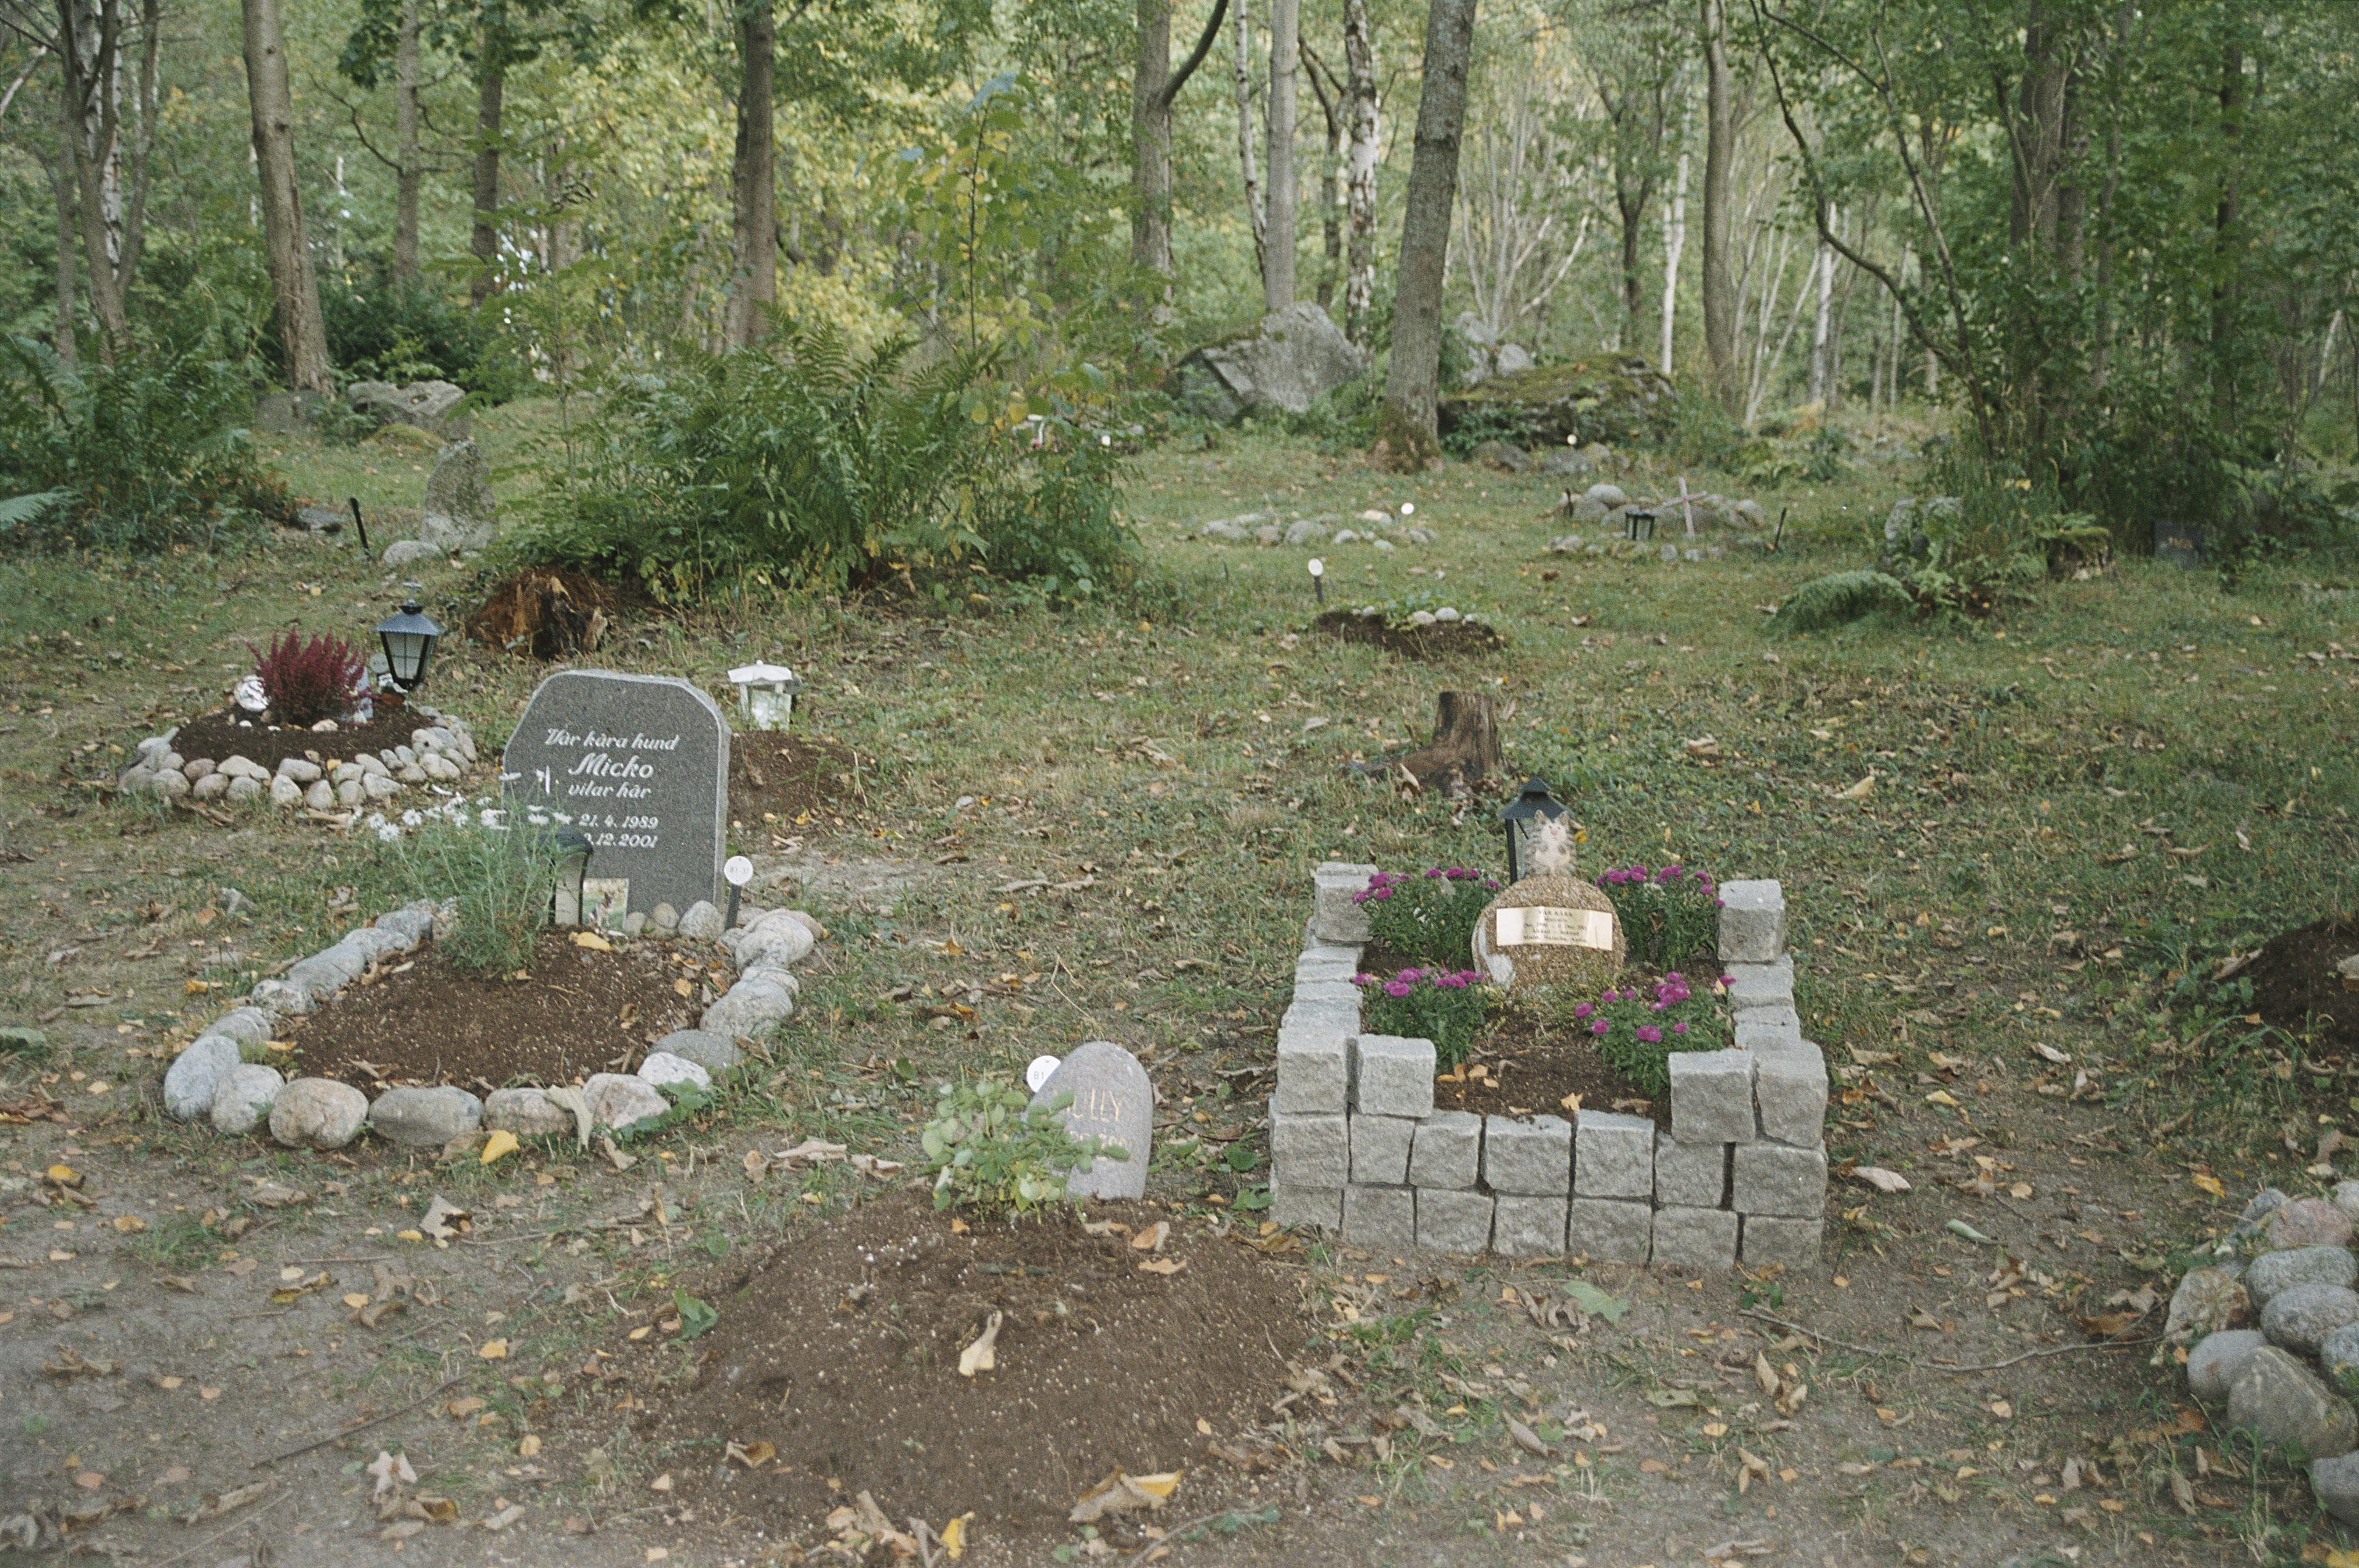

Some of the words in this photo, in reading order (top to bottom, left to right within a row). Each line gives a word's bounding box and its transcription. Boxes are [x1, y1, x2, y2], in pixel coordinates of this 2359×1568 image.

[544, 728, 581, 746] Vår
[631, 732, 680, 750] hund
[568, 752, 654, 779] Micko
[568, 780, 614, 797] vilar
[621, 815, 659, 829] 1989
